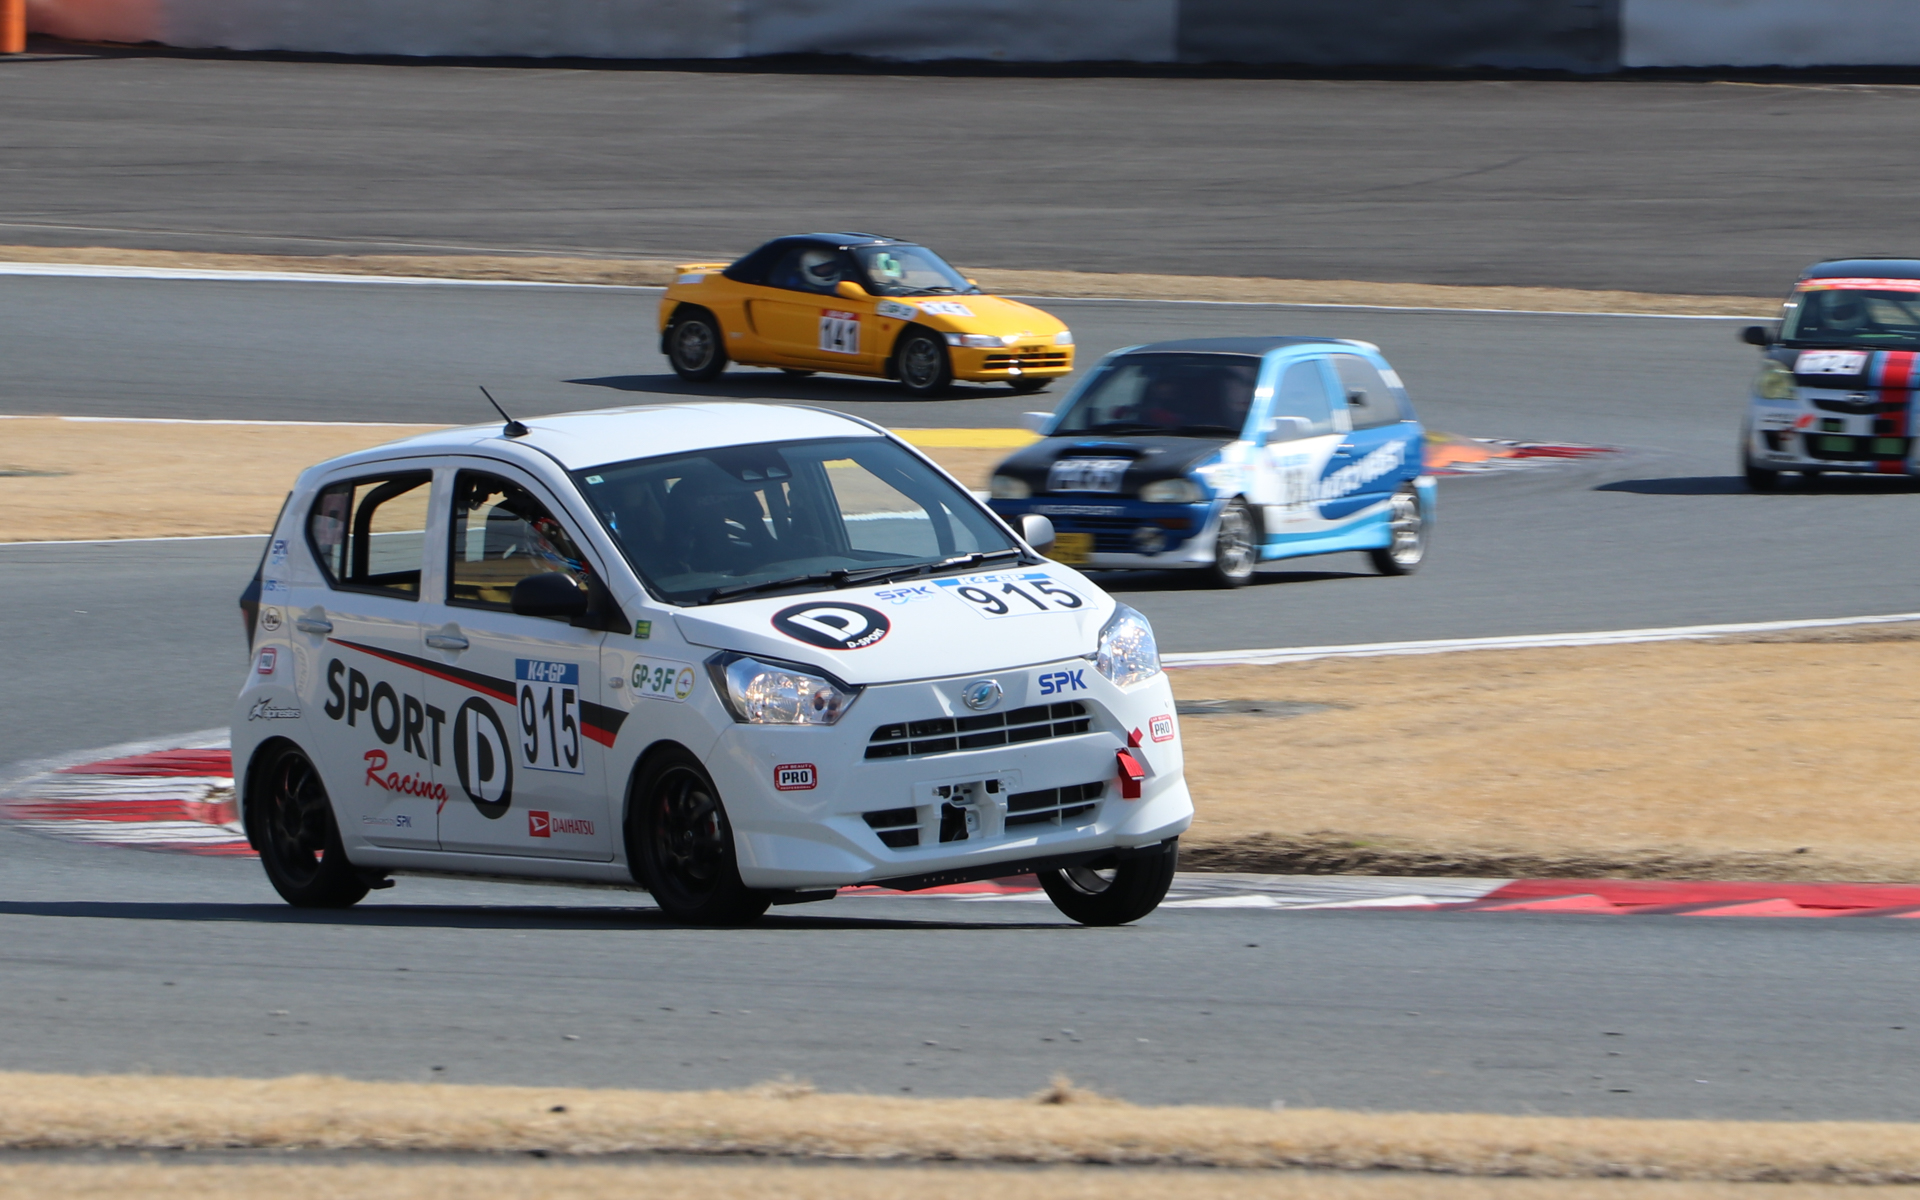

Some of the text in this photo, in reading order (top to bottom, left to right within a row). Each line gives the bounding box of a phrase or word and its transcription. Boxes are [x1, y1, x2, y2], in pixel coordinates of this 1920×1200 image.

[822, 318, 857, 352] 141
[957, 573, 1025, 585] K4-GP
[874, 586, 936, 601] SPK
[957, 580, 1082, 615] 915
[846, 627, 885, 649] D-SPORT
[527, 660, 566, 683] K4-GP
[631, 663, 675, 692] GP-3F
[1038, 669, 1087, 695] SPK
[324, 658, 446, 767] SPORT
[520, 684, 579, 769] 915
[1154, 721, 1170, 735] PRO
[364, 749, 449, 815] Racing
[782, 770, 809, 784] PRO
[396, 815, 412, 828] SPK
[552, 818, 595, 835] DAIHATSU
